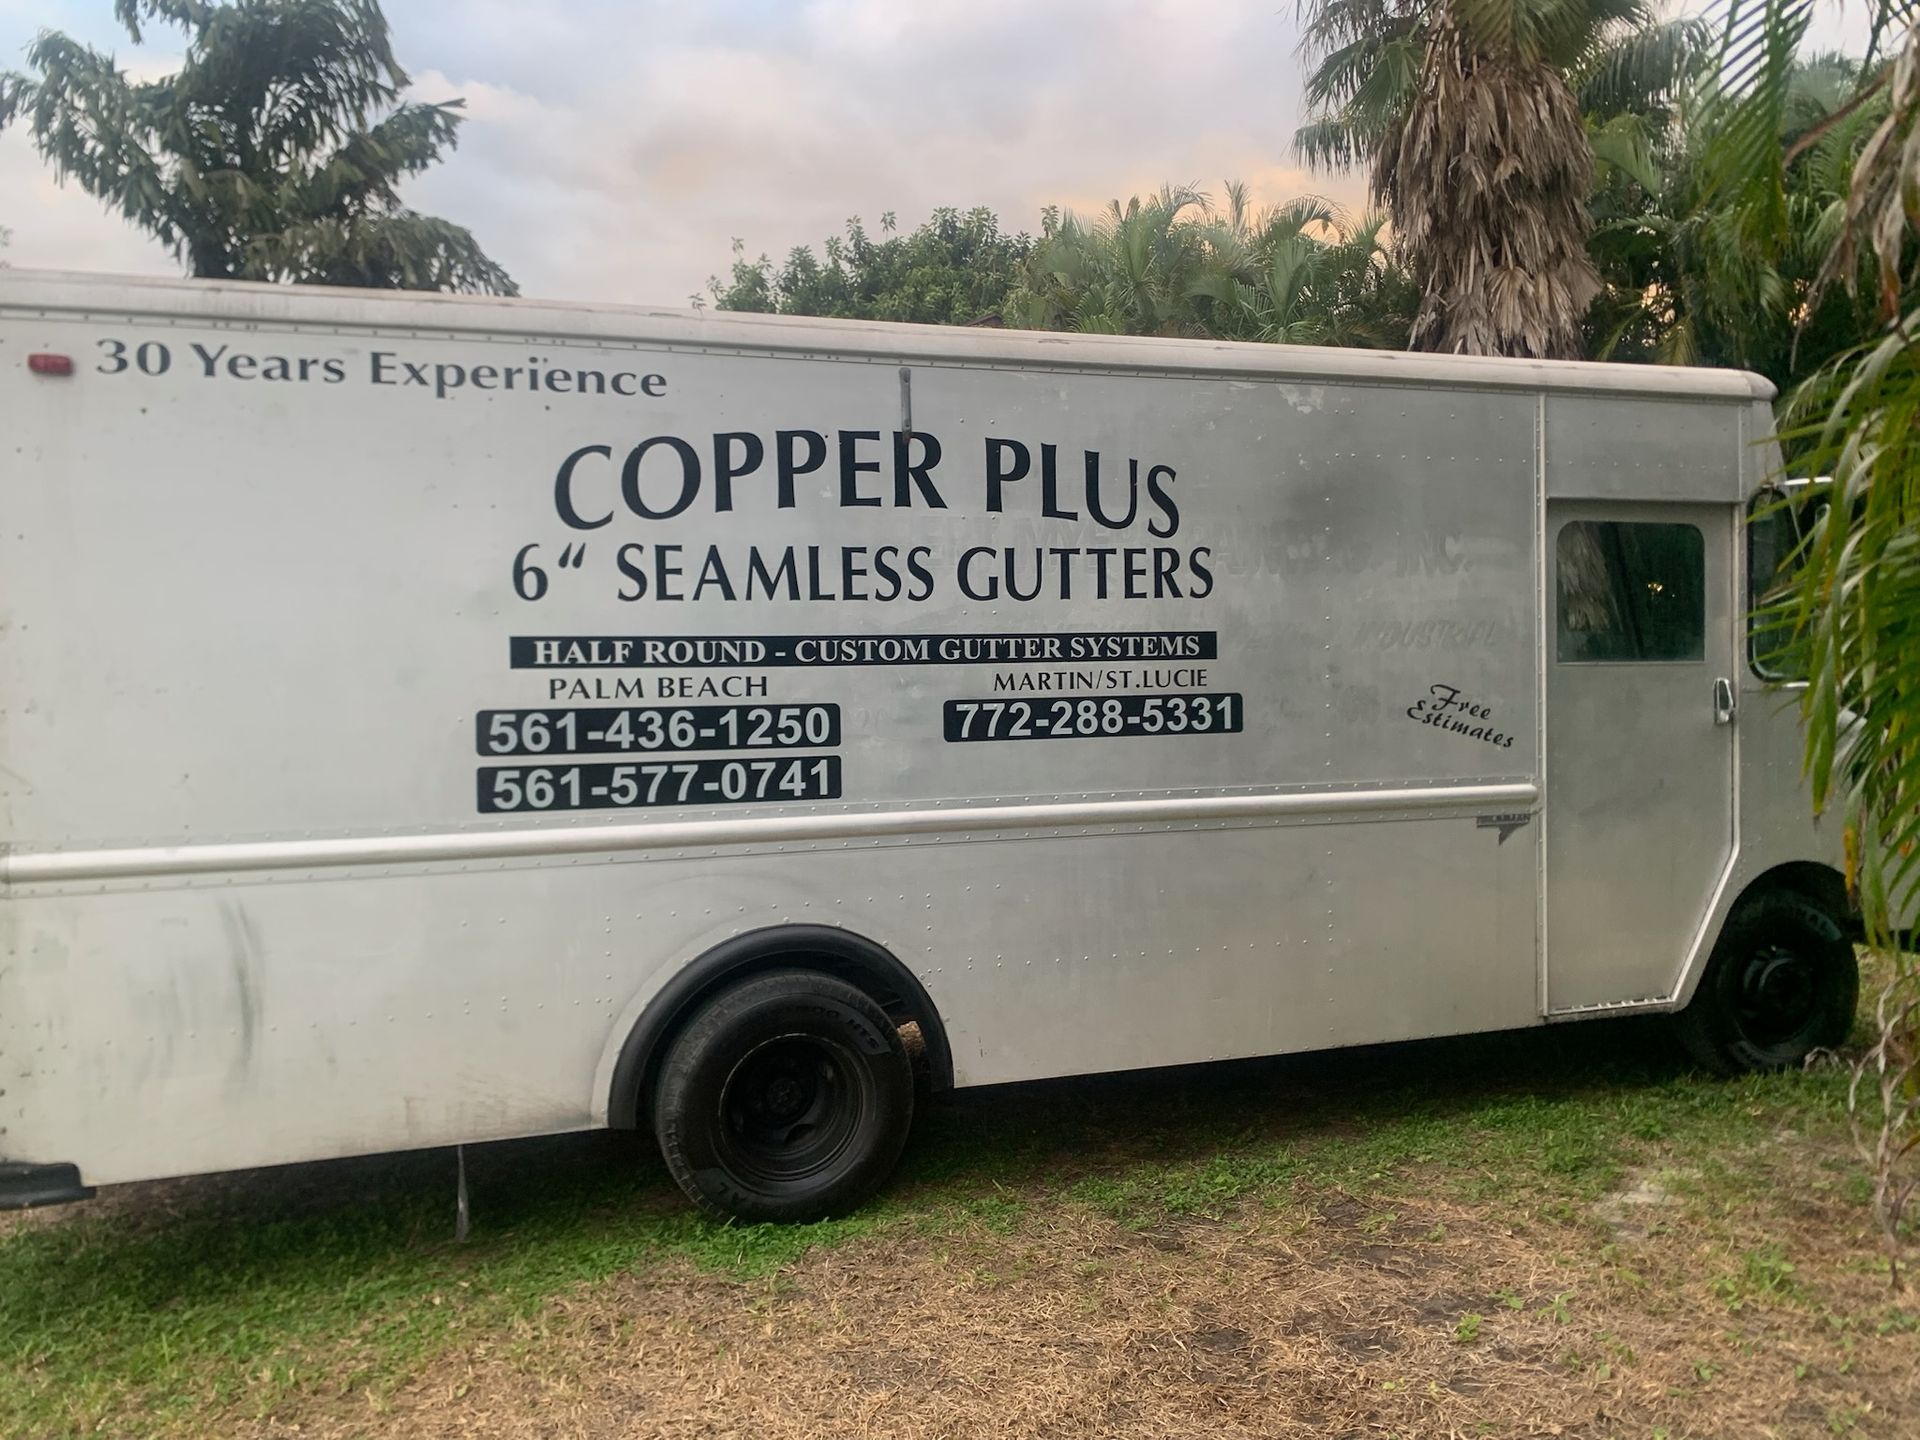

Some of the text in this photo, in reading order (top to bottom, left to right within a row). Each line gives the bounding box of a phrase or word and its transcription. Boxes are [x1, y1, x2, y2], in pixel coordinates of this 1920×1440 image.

[97, 340, 667, 398] 30 Years Experience
[555, 429, 1180, 538] COPPER PLUS
[616, 543, 934, 601] SEAMLESS
[957, 546, 1213, 601] GUTTERS
[533, 641, 633, 664] HALF
[643, 640, 766, 663] ROUND
[794, 639, 930, 662] CUSTOM
[938, 637, 1062, 660] GUTTER
[1070, 635, 1200, 656] SYSTEMS
[549, 676, 768, 699] PALM BEACH
[1429, 684, 1491, 720] Free
[488, 706, 830, 753] 561-436-1250
[955, 696, 1233, 739] 772-288-5331
[1406, 700, 1514, 748] Estimates
[493, 759, 829, 809] 561-577-0741
